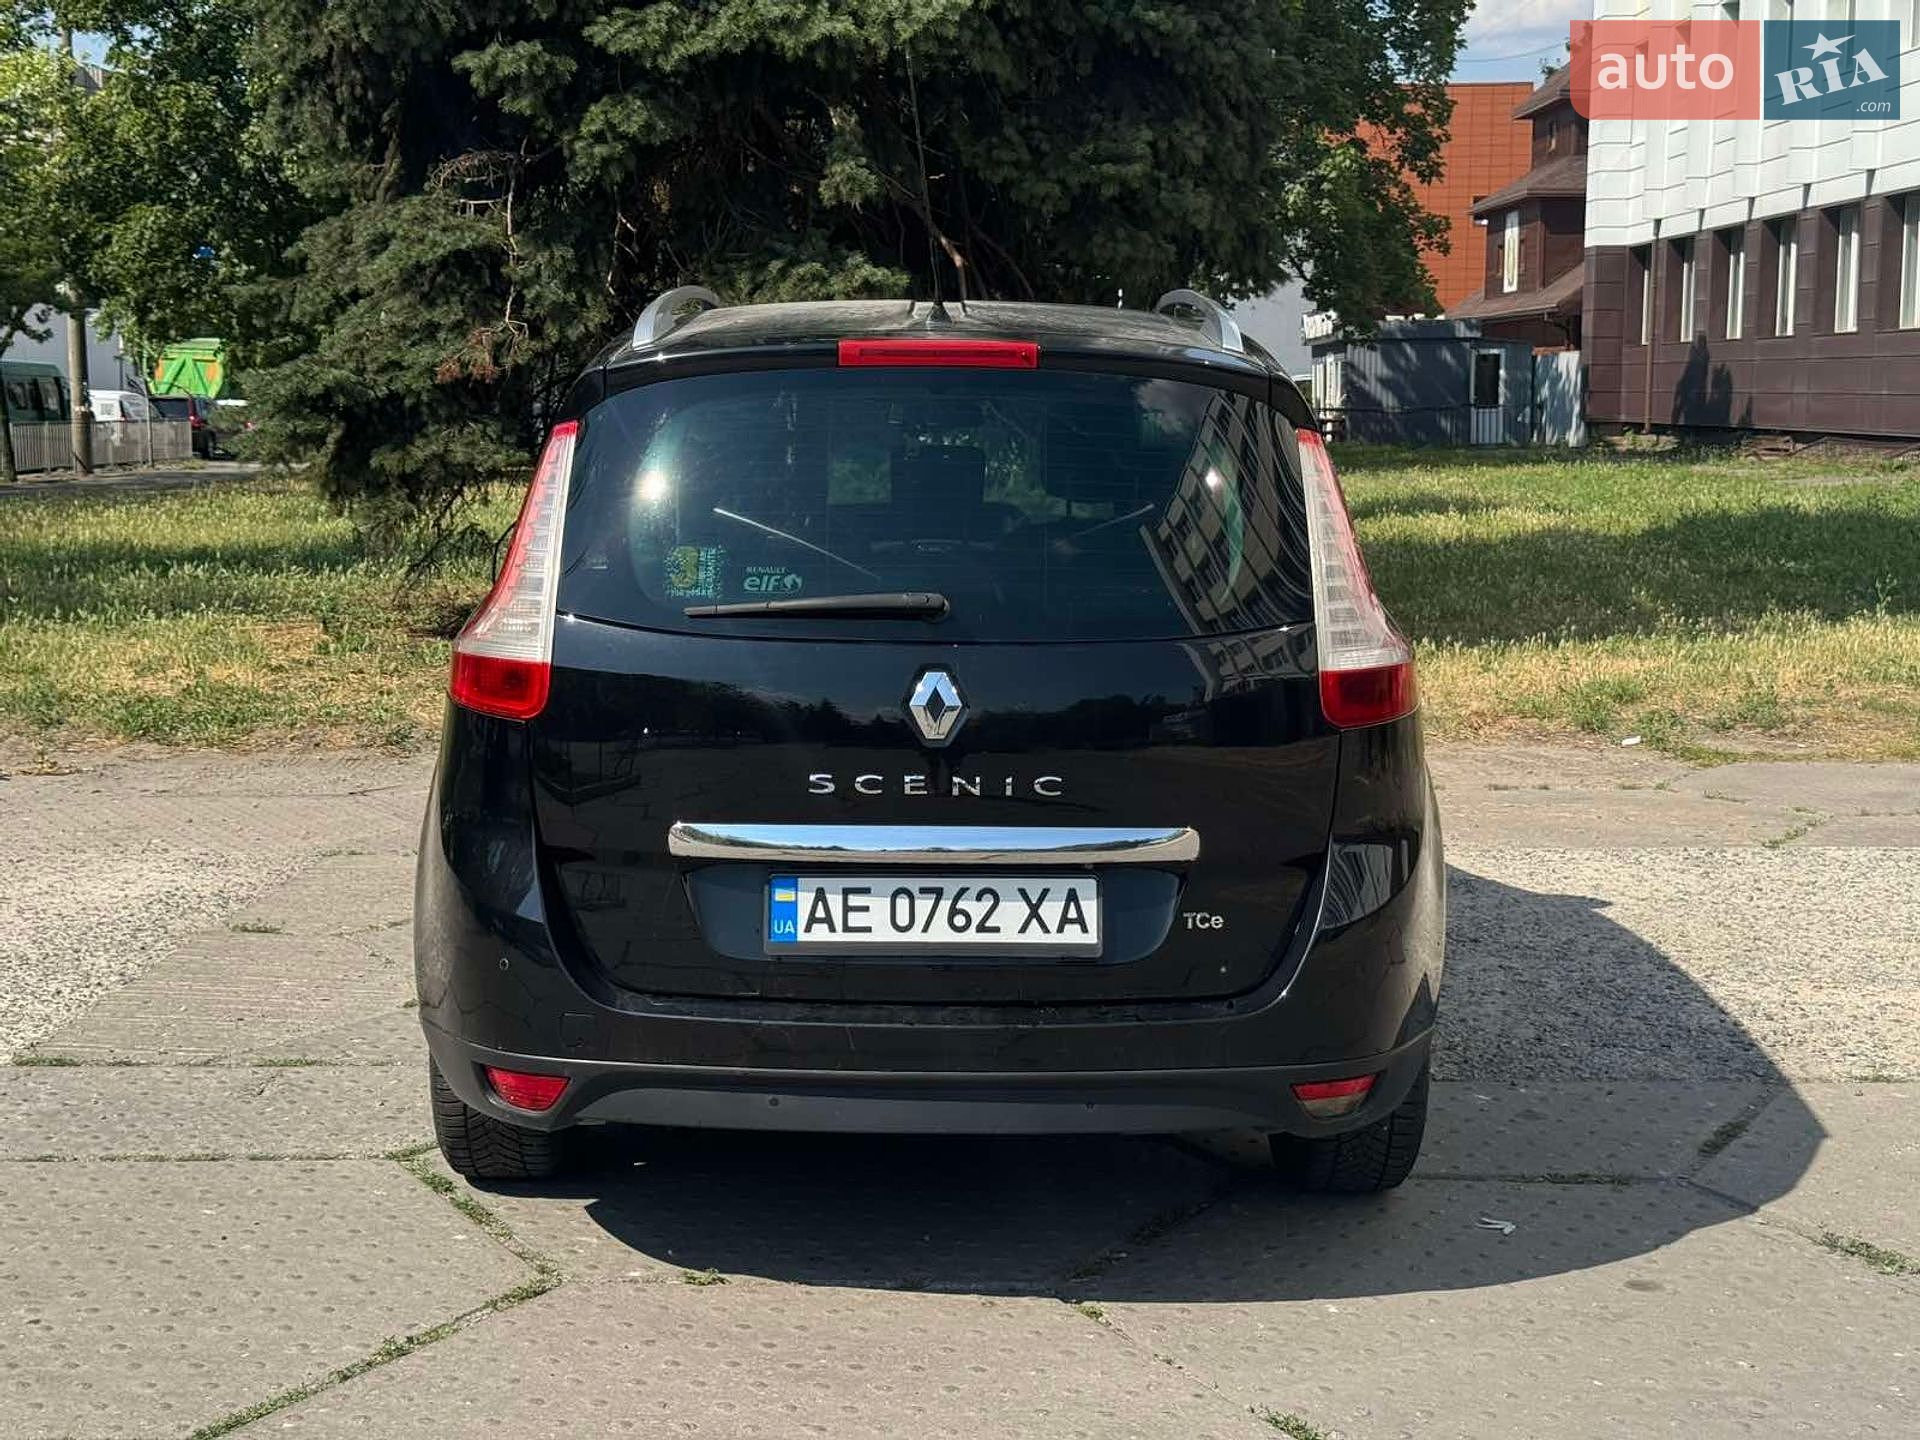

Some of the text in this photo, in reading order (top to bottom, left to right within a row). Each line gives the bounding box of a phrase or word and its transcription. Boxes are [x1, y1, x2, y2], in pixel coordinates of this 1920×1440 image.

[745, 565, 788, 574] RENAULT
[743, 574, 780, 591] elf
[808, 773, 1063, 796] SCENIC
[803, 887, 1089, 934] AE 0762 XA
[774, 922, 795, 934] UA
[1183, 912, 1224, 929] TCe
